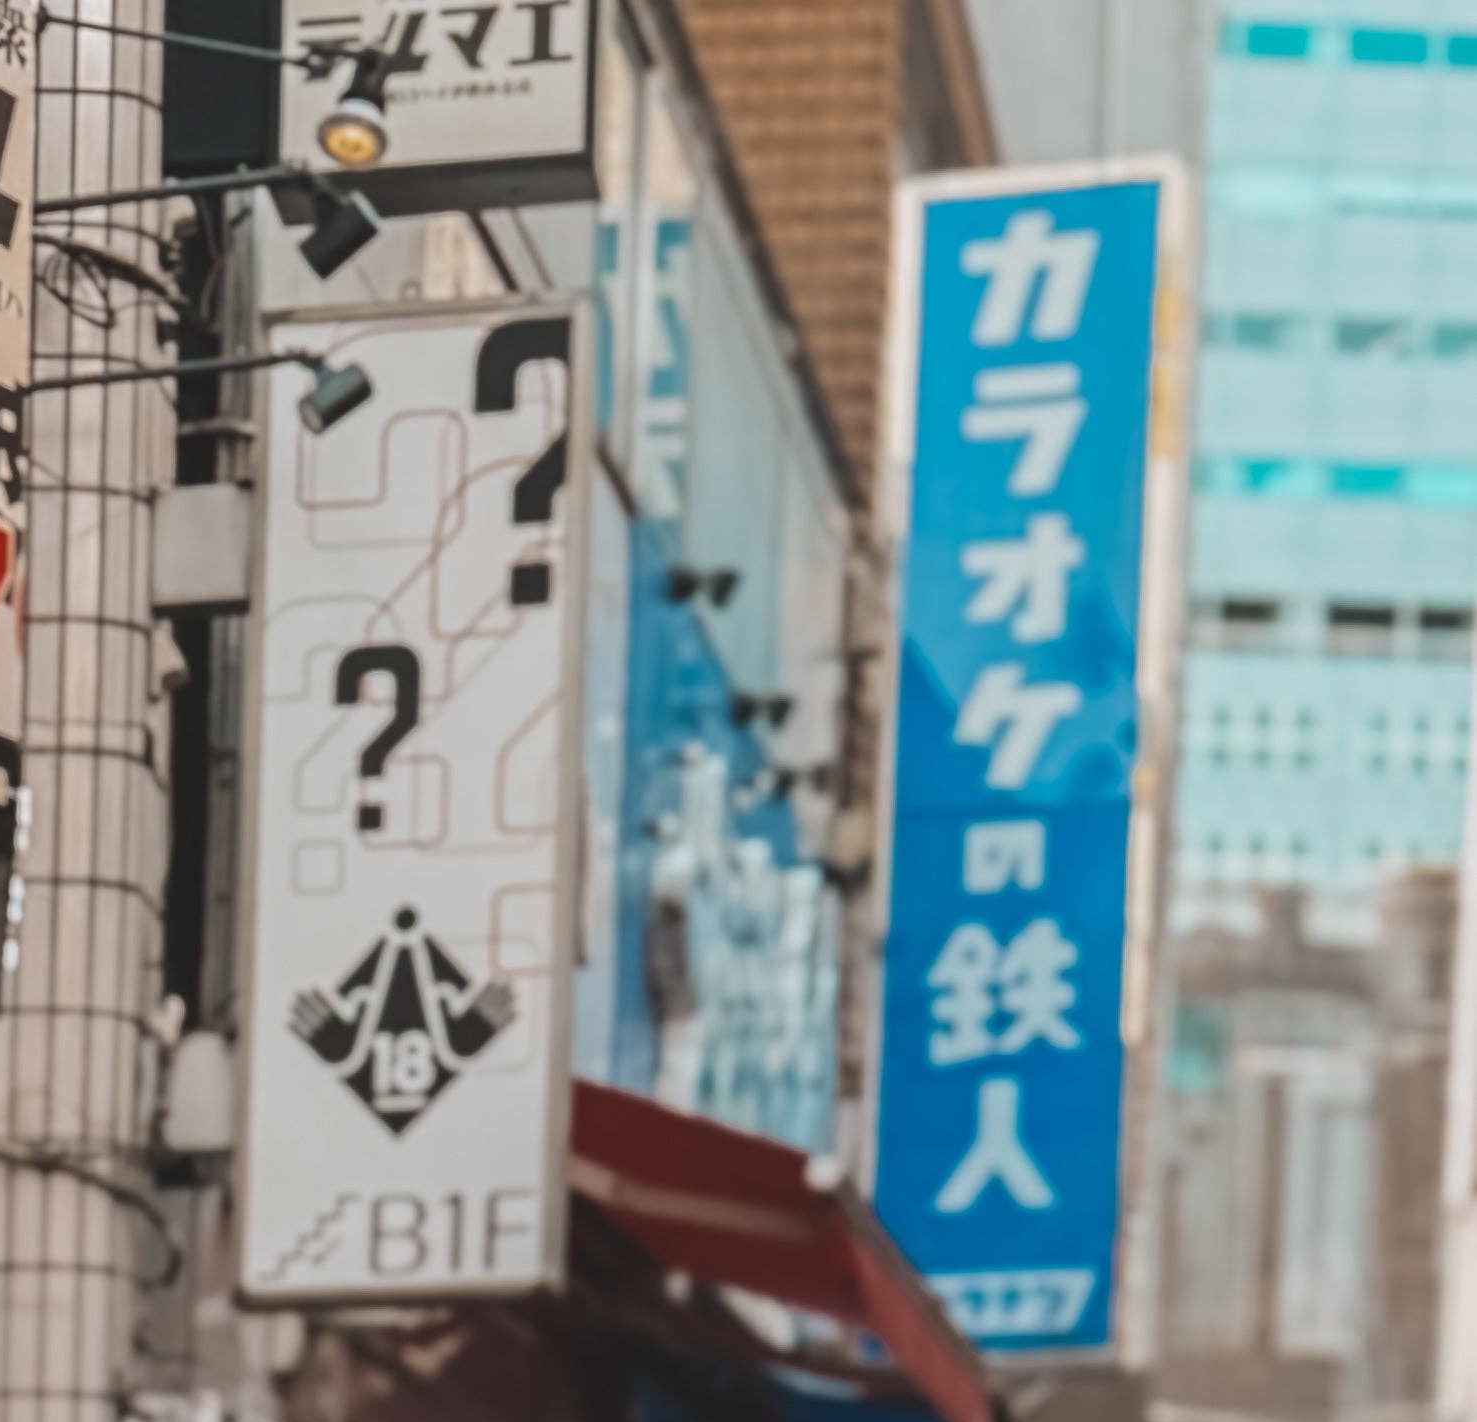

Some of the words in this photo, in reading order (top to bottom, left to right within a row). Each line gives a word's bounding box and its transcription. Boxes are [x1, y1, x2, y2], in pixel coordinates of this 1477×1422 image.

[928, 208, 1100, 1213] カラオケの鉄人
[368, 1192, 533, 1275] B1F
